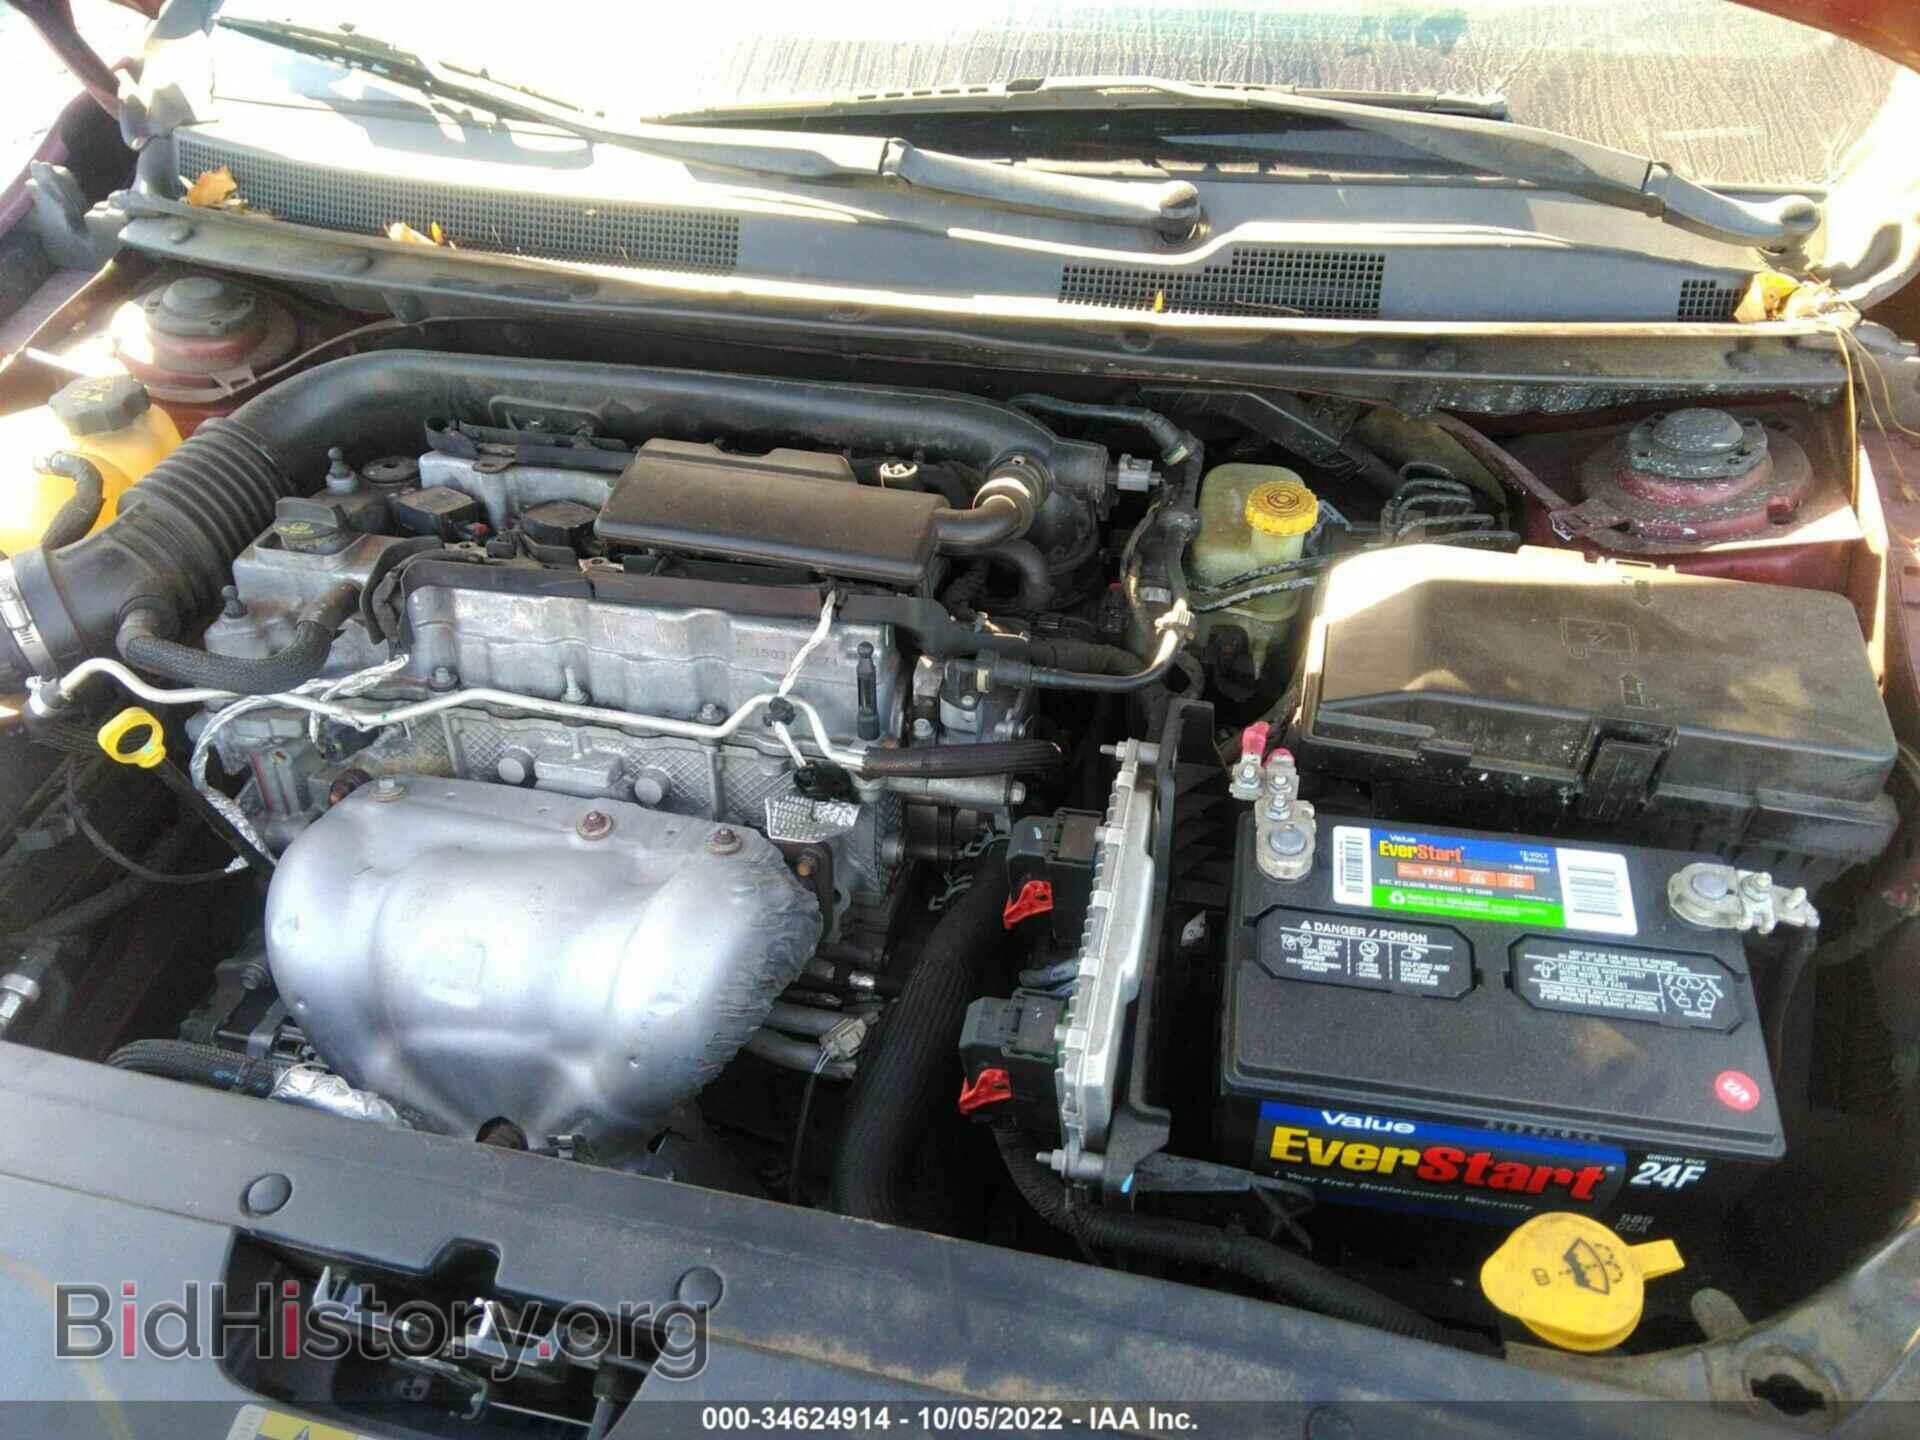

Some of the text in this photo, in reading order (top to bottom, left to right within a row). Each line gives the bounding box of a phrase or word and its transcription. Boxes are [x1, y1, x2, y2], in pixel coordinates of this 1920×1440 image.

[1379, 839, 1462, 863] EverStart
[1313, 921, 1366, 937] DANGER
[1379, 929, 1428, 944] POISON
[1320, 1110, 1416, 1133] Value
[1269, 1125, 1607, 1201] EverStart
[1645, 1153, 1683, 1163] GROUP
[1629, 1161, 1707, 1189] 24F
[1321, 1176, 1354, 1189] Free
[1359, 1182, 1461, 1201] Replacement
[1464, 1195, 1534, 1212] Warranty
